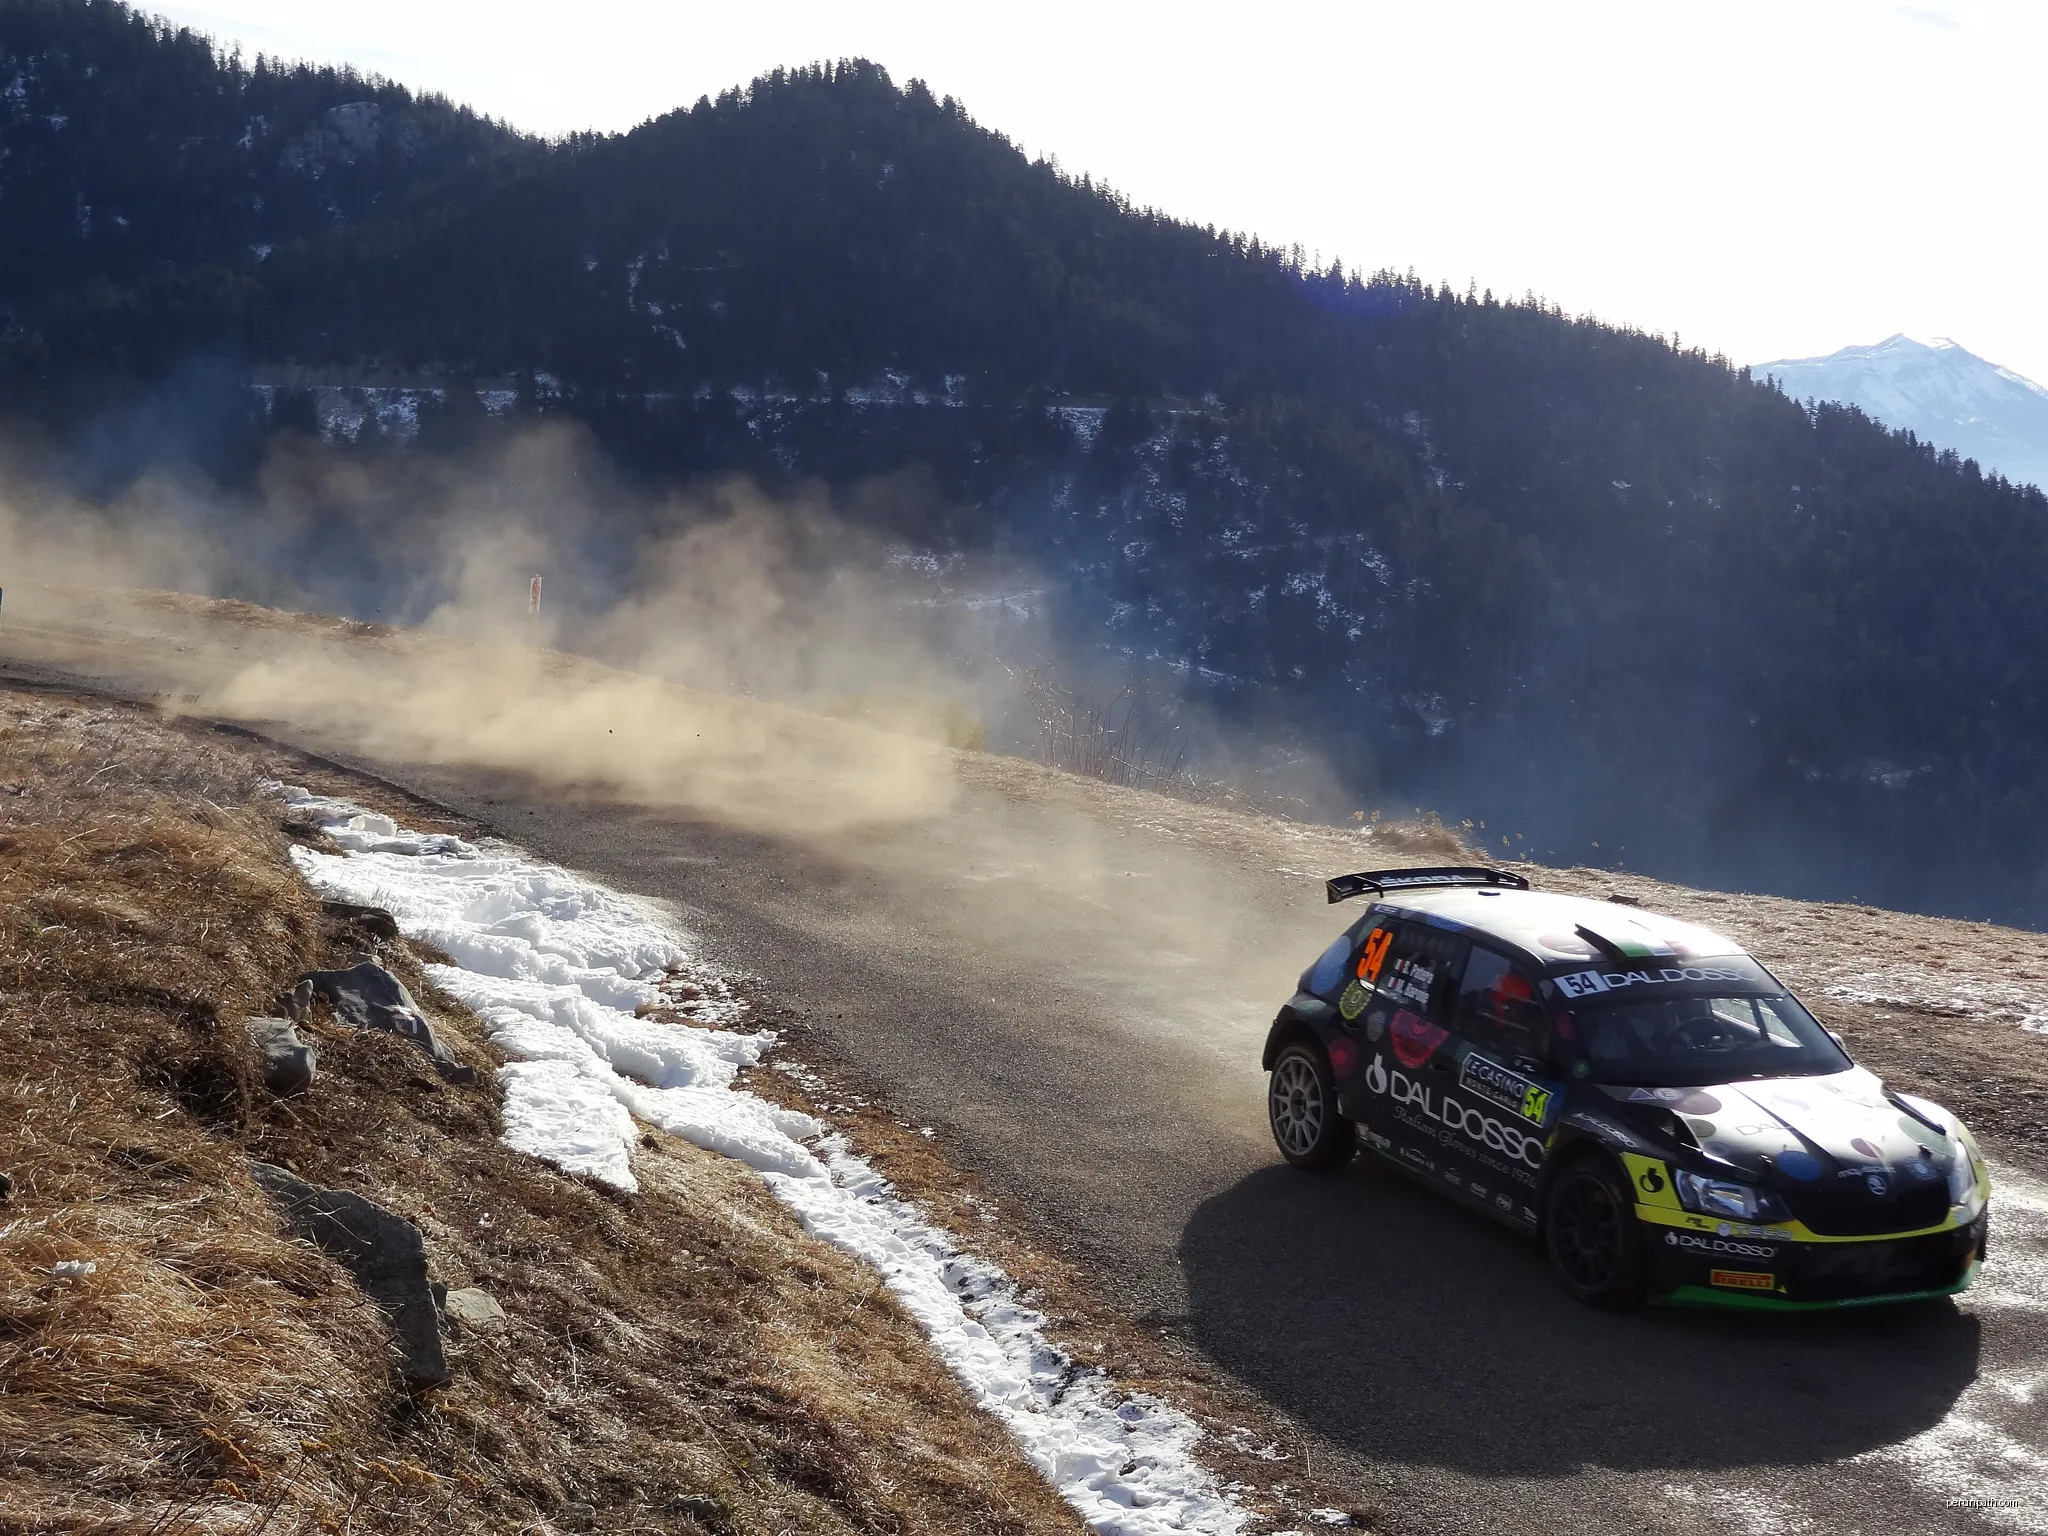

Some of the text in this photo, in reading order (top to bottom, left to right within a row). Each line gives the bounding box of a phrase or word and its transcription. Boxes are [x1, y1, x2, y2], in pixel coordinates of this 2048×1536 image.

[1357, 927, 1393, 982] 54
[1567, 974, 1597, 994] 54
[1602, 968, 1757, 988] DALDOSSO
[1524, 1086, 1548, 1122] 54
[1680, 1235, 1775, 1258] DALDOSSO
